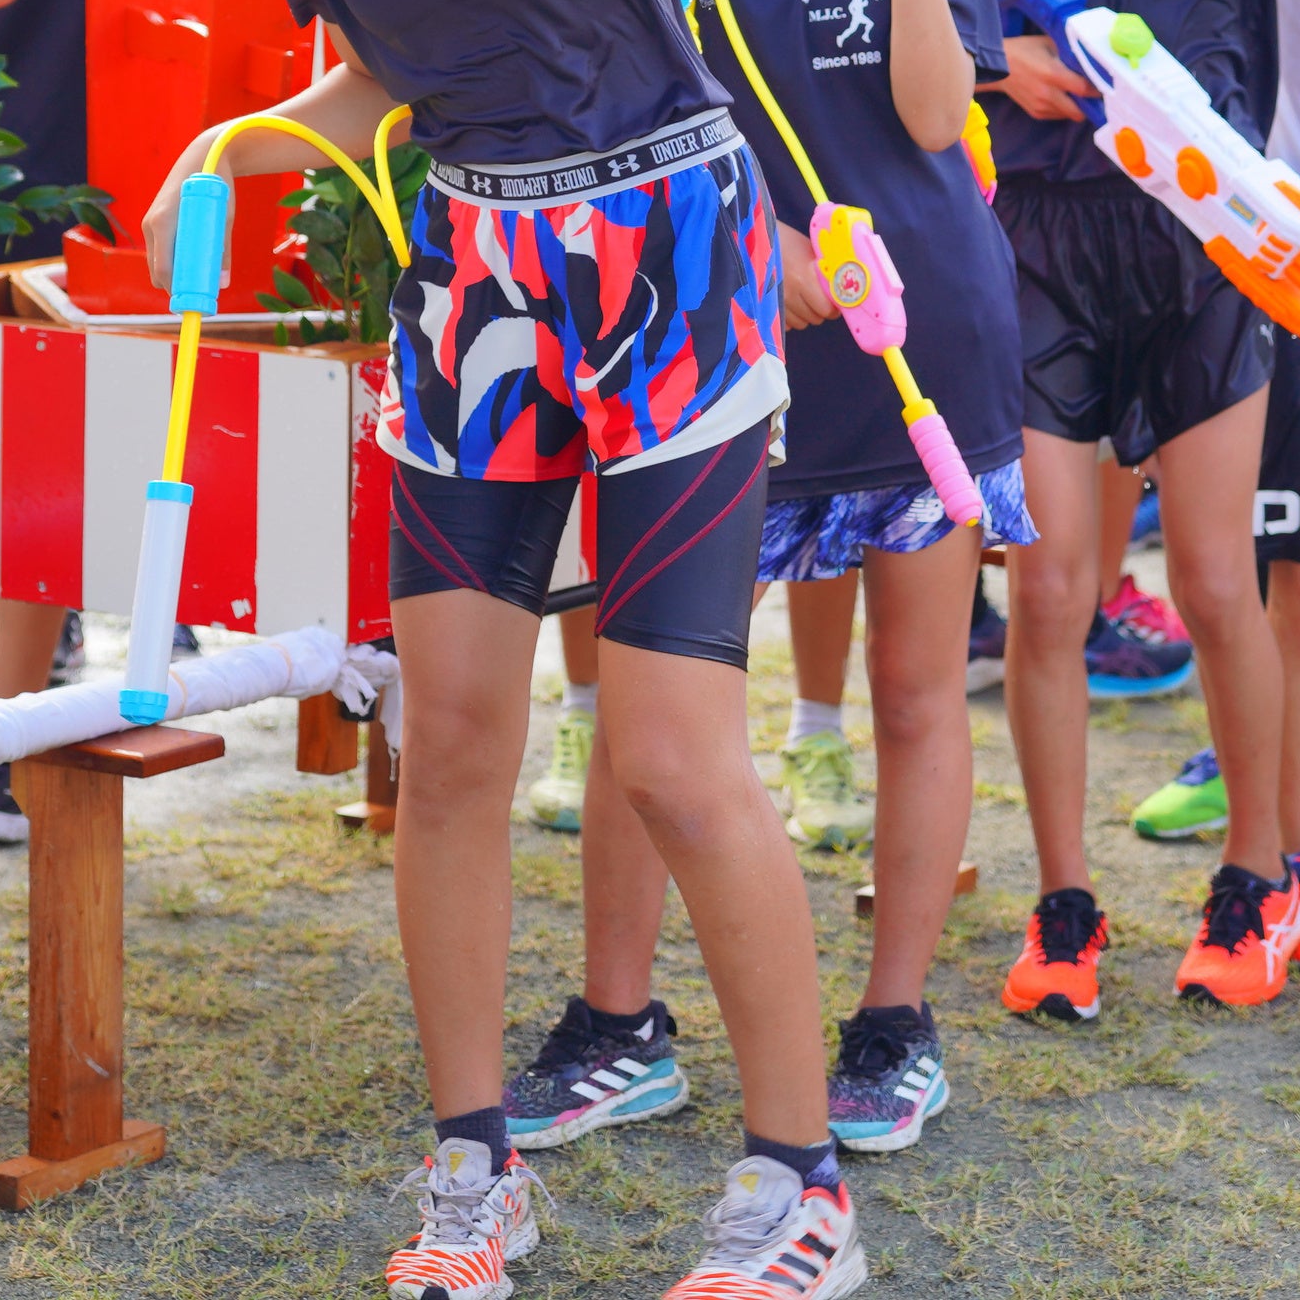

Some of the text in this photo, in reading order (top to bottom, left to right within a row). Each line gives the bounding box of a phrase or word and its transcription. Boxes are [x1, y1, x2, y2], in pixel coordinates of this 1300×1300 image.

[812, 50, 882, 71] Since 1988
[649, 131, 701, 166] UNDER
[499, 165, 599, 198] UNDER ARMOUR
